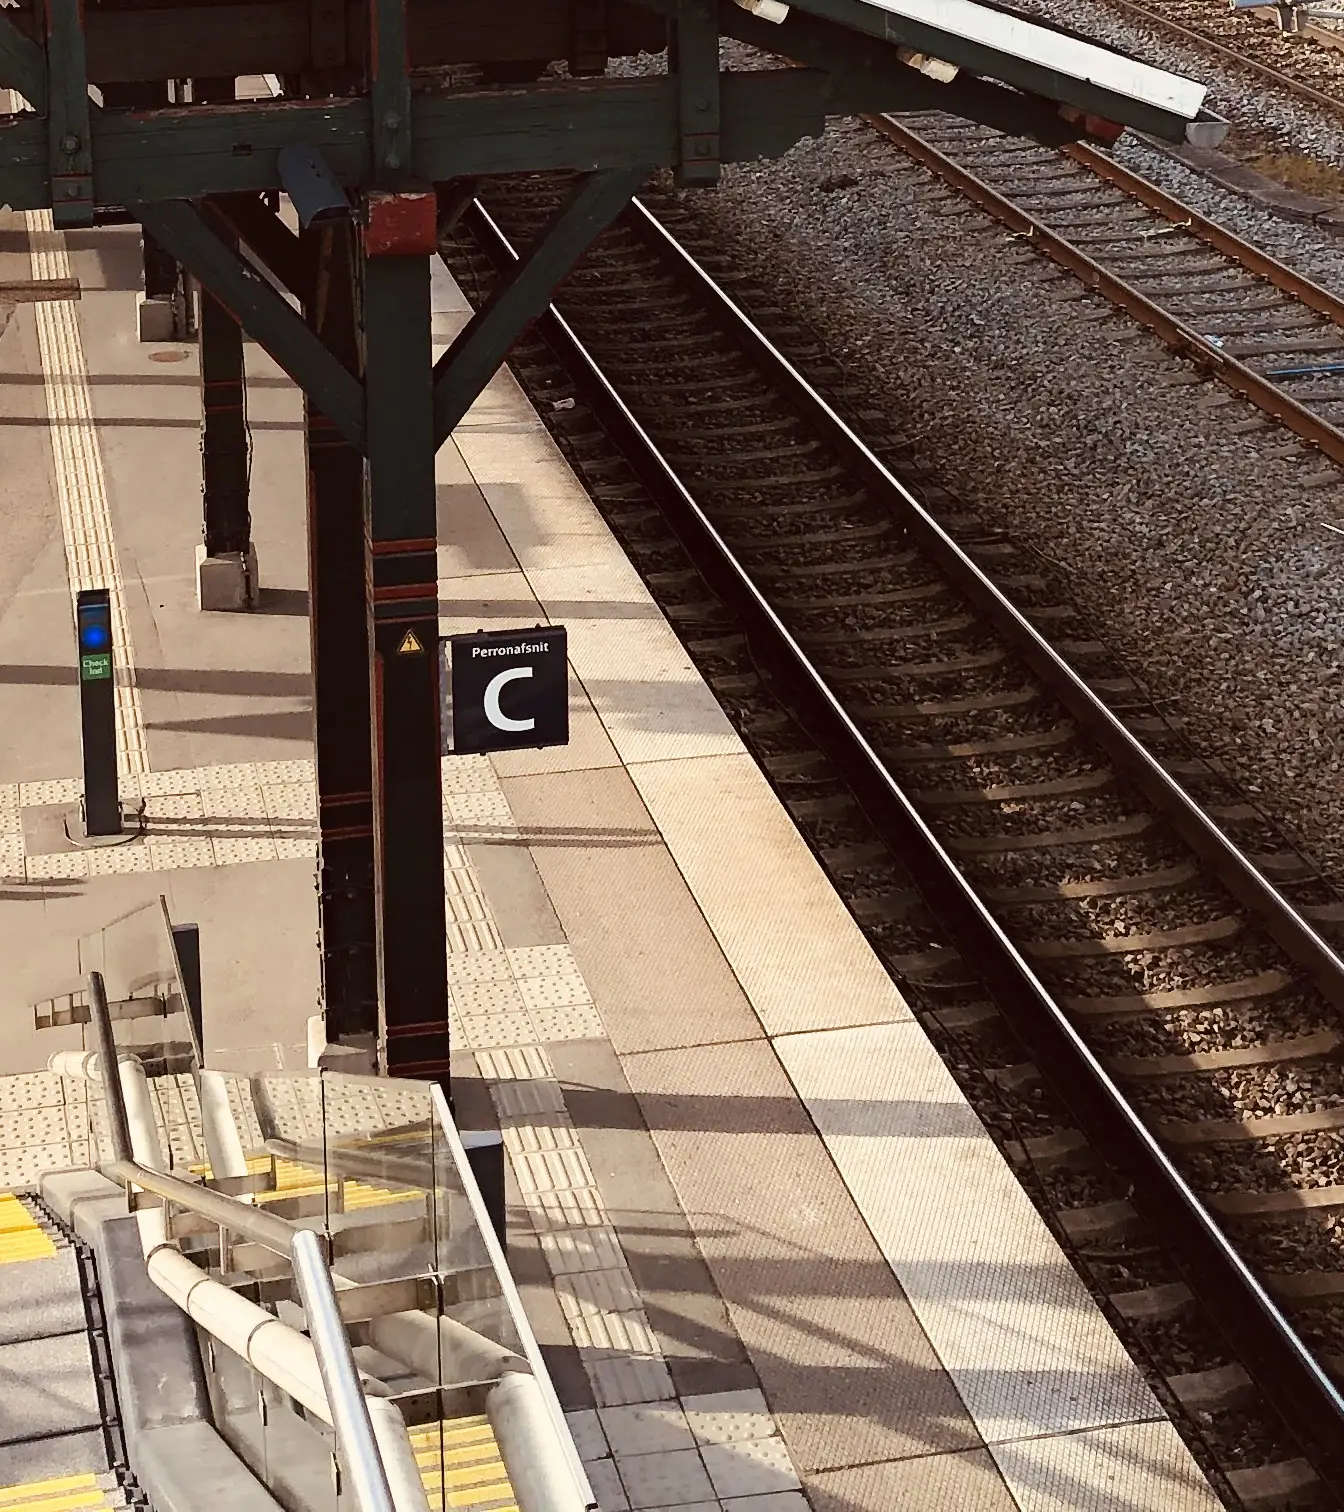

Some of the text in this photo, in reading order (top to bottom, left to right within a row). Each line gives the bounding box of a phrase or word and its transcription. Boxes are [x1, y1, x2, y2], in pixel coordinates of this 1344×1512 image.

[472, 642, 549, 658] Perronafsnit
[83, 659, 108, 668] Check
[483, 666, 535, 732] C
